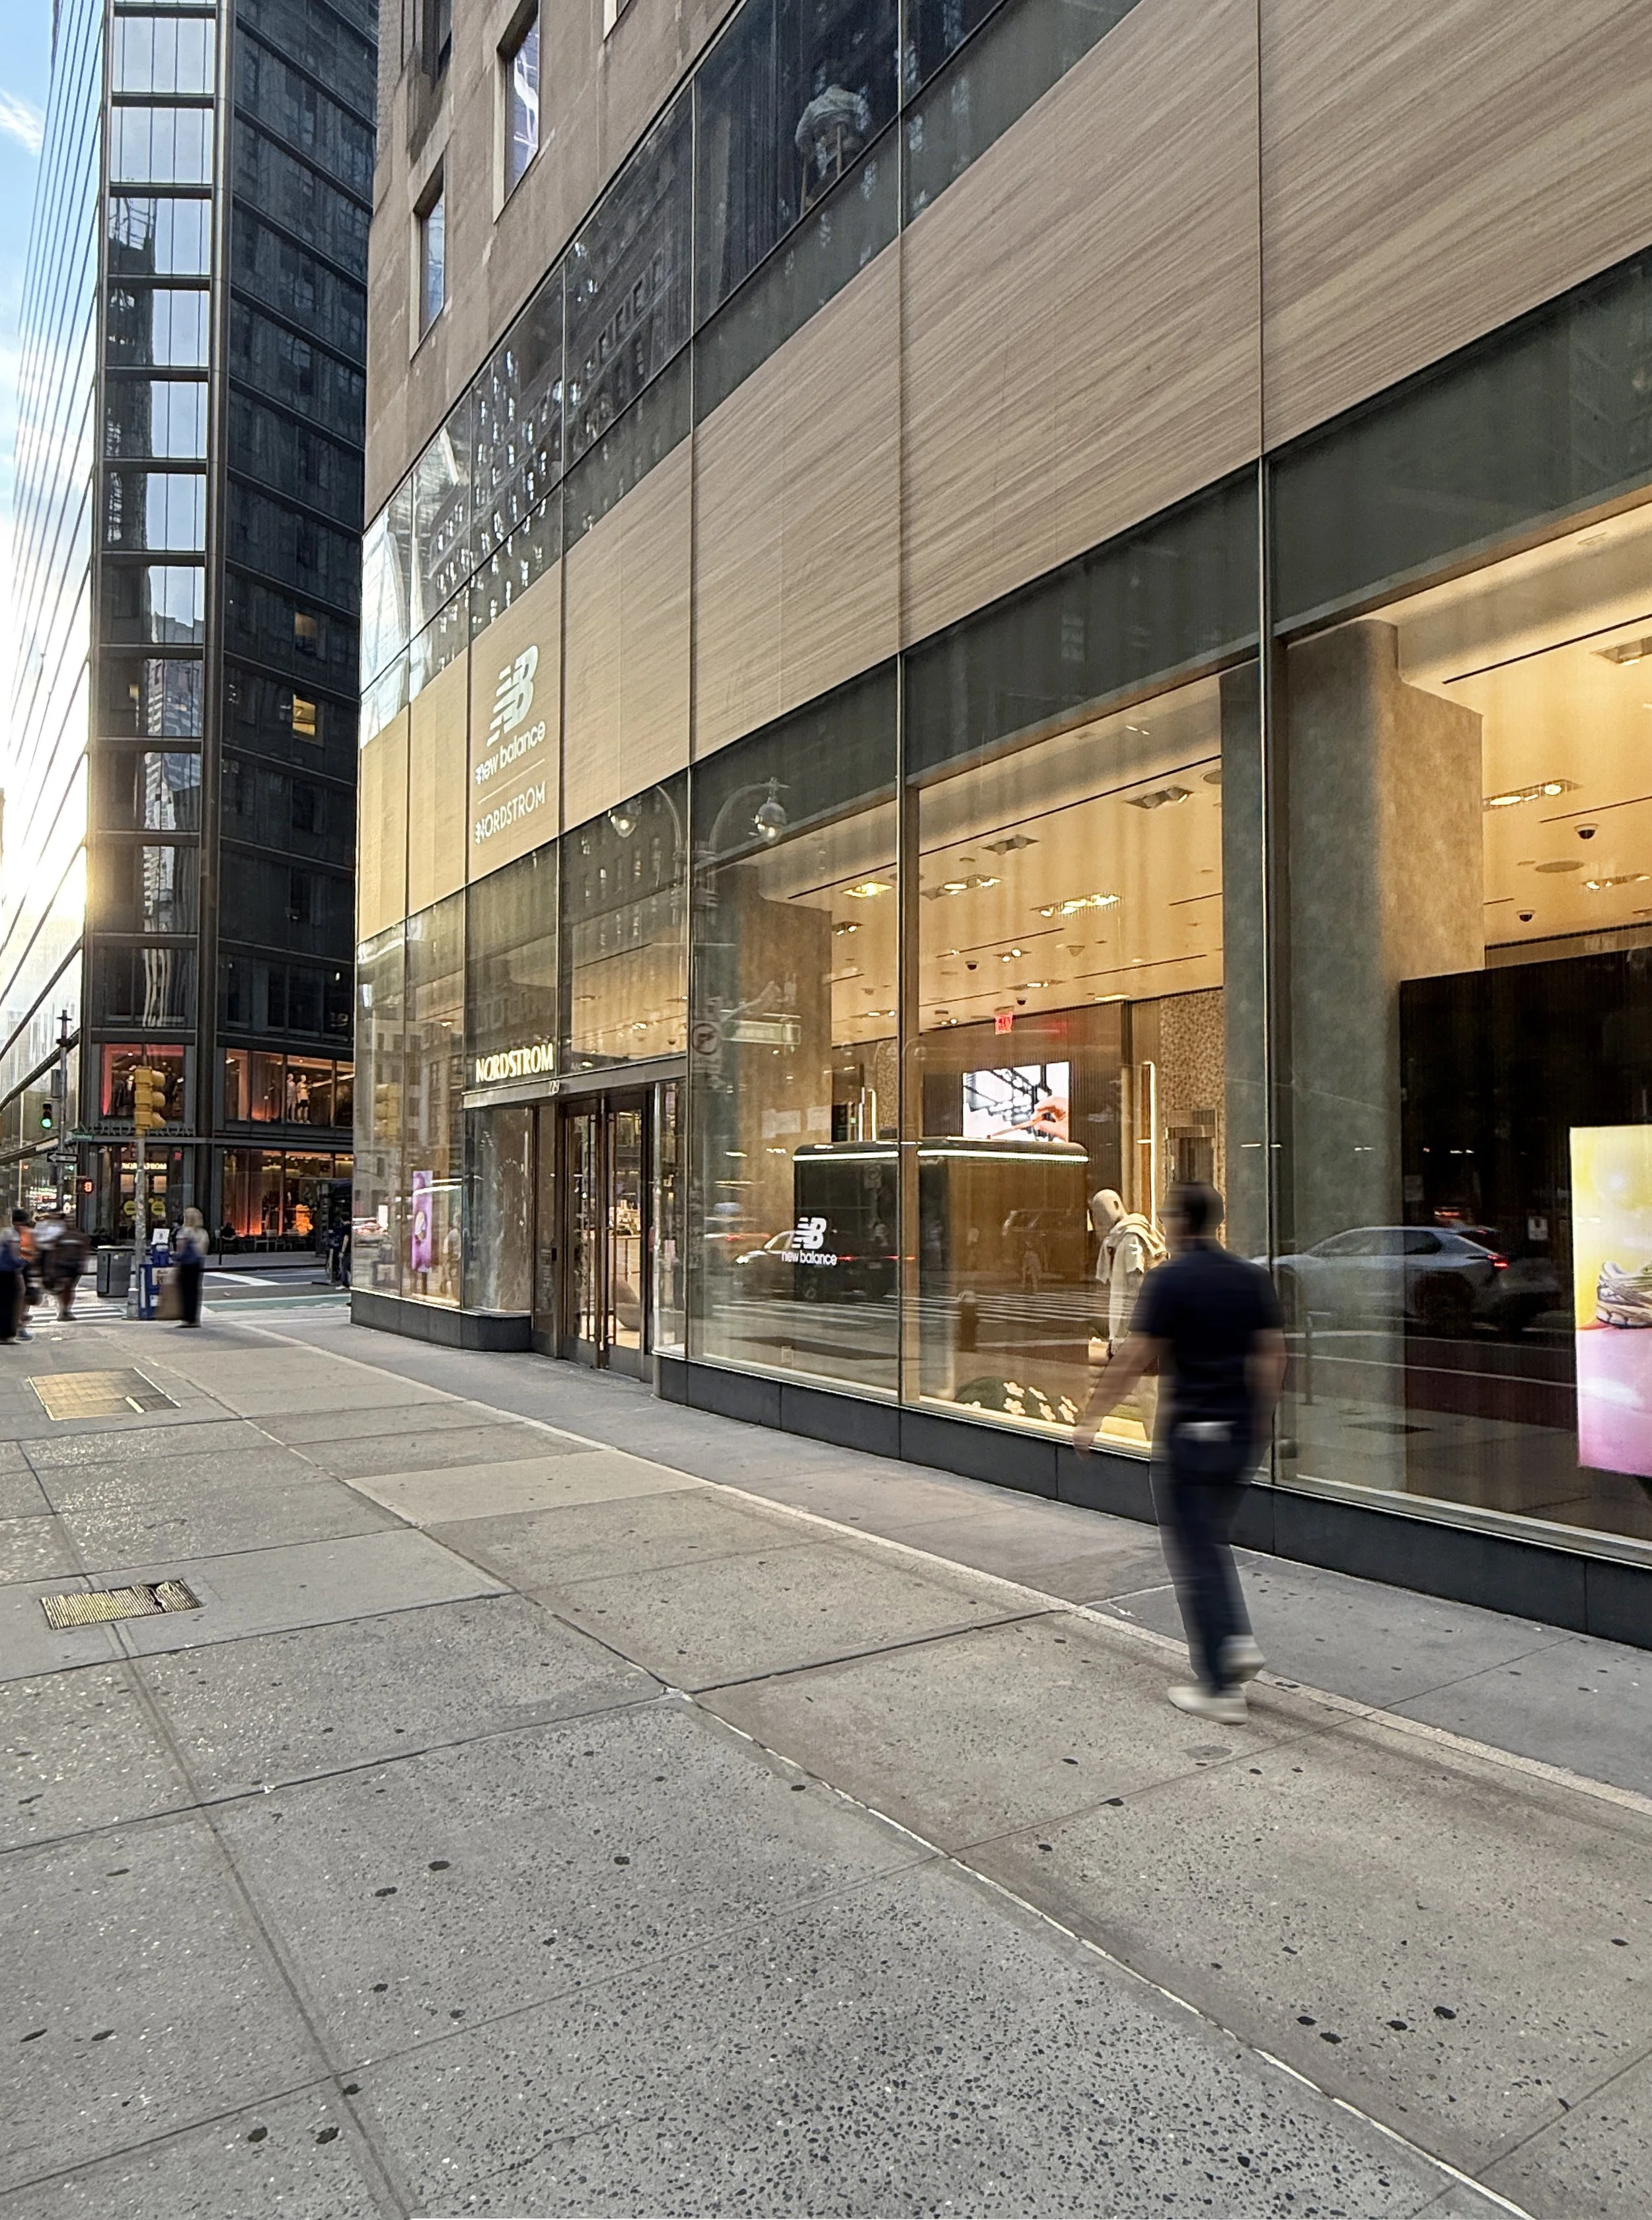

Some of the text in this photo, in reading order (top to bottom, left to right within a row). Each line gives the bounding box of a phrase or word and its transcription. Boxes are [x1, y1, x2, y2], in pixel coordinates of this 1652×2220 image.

[475, 720, 546, 784] new balance
[475, 780, 546, 844] NORDSTROM
[476, 1043, 553, 1083] NORDSTROM
[78, 1121, 196, 1137] NORDROM
[781, 1249, 838, 1266] new balance
